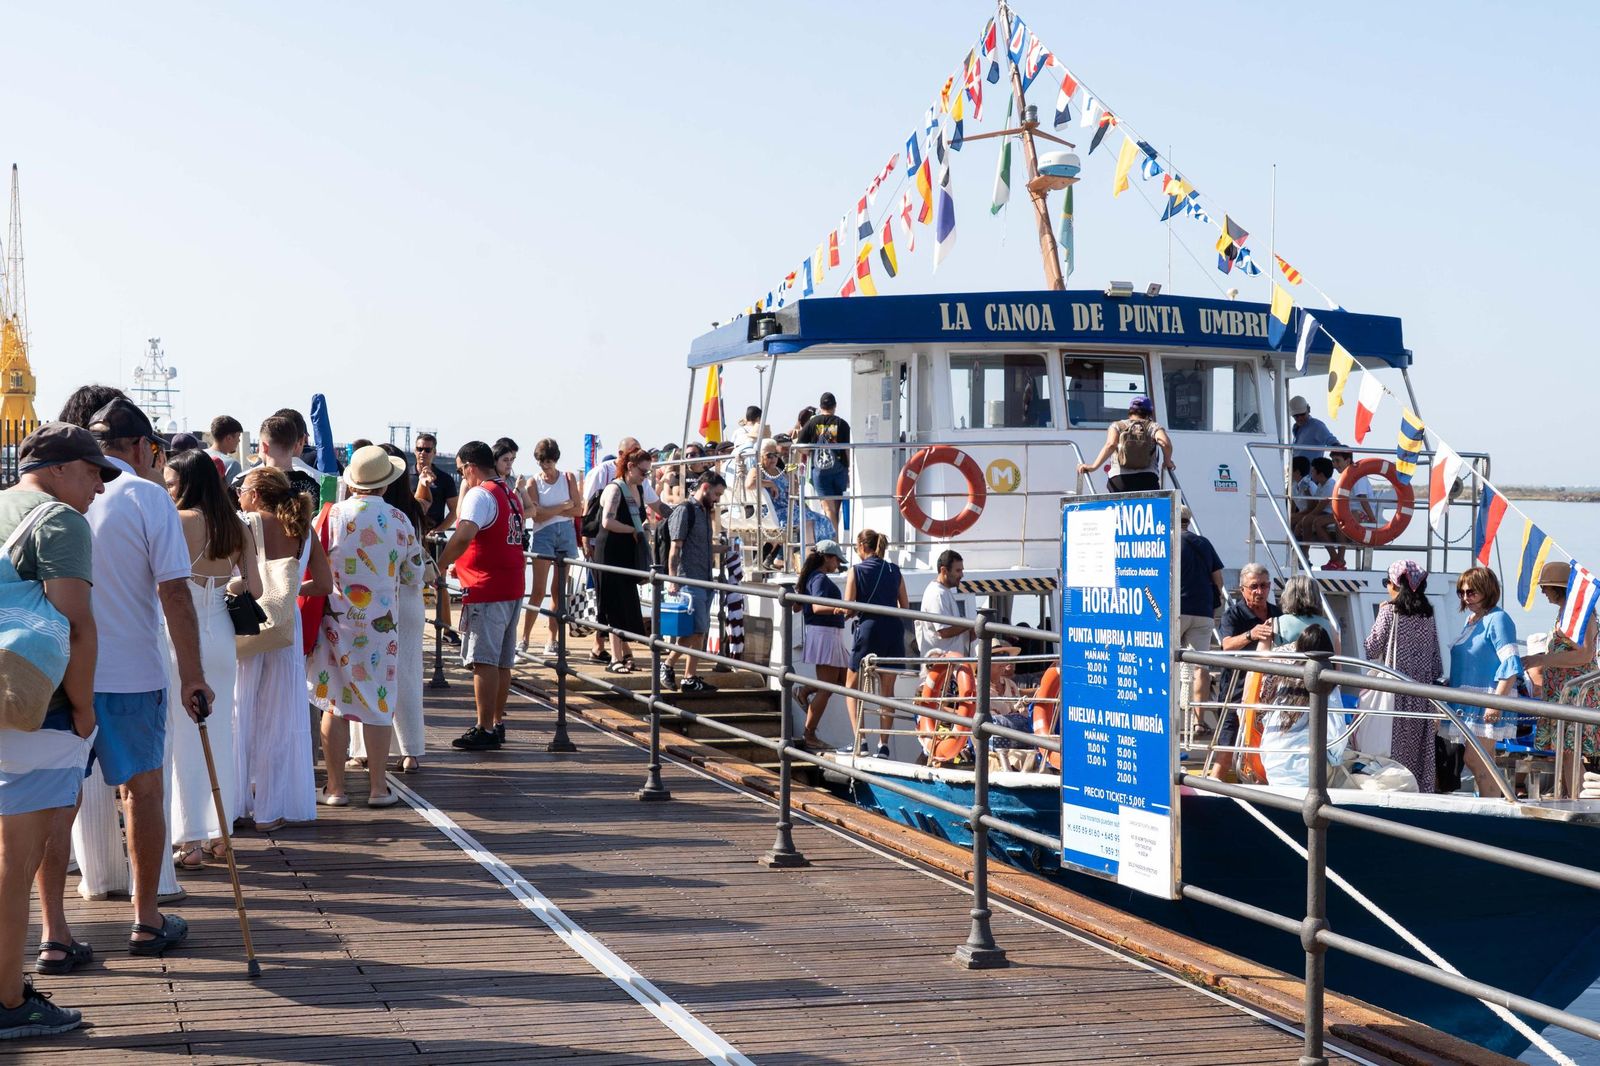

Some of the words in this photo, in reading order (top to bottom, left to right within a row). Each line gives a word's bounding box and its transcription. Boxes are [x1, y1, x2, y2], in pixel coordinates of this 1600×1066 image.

[940, 302, 972, 330] LA
[984, 303, 1055, 332] CANOA
[1072, 303, 1104, 332] DE
[1118, 304, 1184, 334] PUNTA
[1198, 308, 1270, 338] UMBRI
[1105, 503, 1154, 536] ANOA
[1156, 520, 1166, 535] de
[1132, 538, 1166, 559] UMBRÍA
[1138, 568, 1158, 577] Andaluz
[1082, 587, 1143, 615] HORARIO
[1068, 627, 1093, 643] PUNTA
[1126, 630, 1132, 646] A
[1134, 630, 1164, 648] HUELVA
[1084, 648, 1110, 660] MAÑANA:
[1118, 652, 1138, 664] TARDE:
[1103, 663, 1108, 673] h
[1133, 666, 1138, 676] h
[1087, 674, 1102, 685] 12.00
[1103, 675, 1108, 685] h
[1133, 678, 1138, 688] h
[1068, 706, 1096, 724] HUELVA
[1098, 710, 1104, 725] A
[1105, 710, 1130, 729] PUNTA
[1132, 714, 1164, 734] UMBRÍA
[1084, 728, 1110, 743] MAÑANA:
[1117, 735, 1137, 747] TARDE:
[1101, 744, 1106, 754] h
[1133, 750, 1137, 760] h
[1102, 757, 1107, 767] h
[1133, 762, 1137, 773] h
[1133, 774, 1137, 785] h
[1084, 786, 1104, 799] PRECIO
[1106, 791, 1128, 804] TICKET:
[1128, 796, 1146, 808] 5,00€
